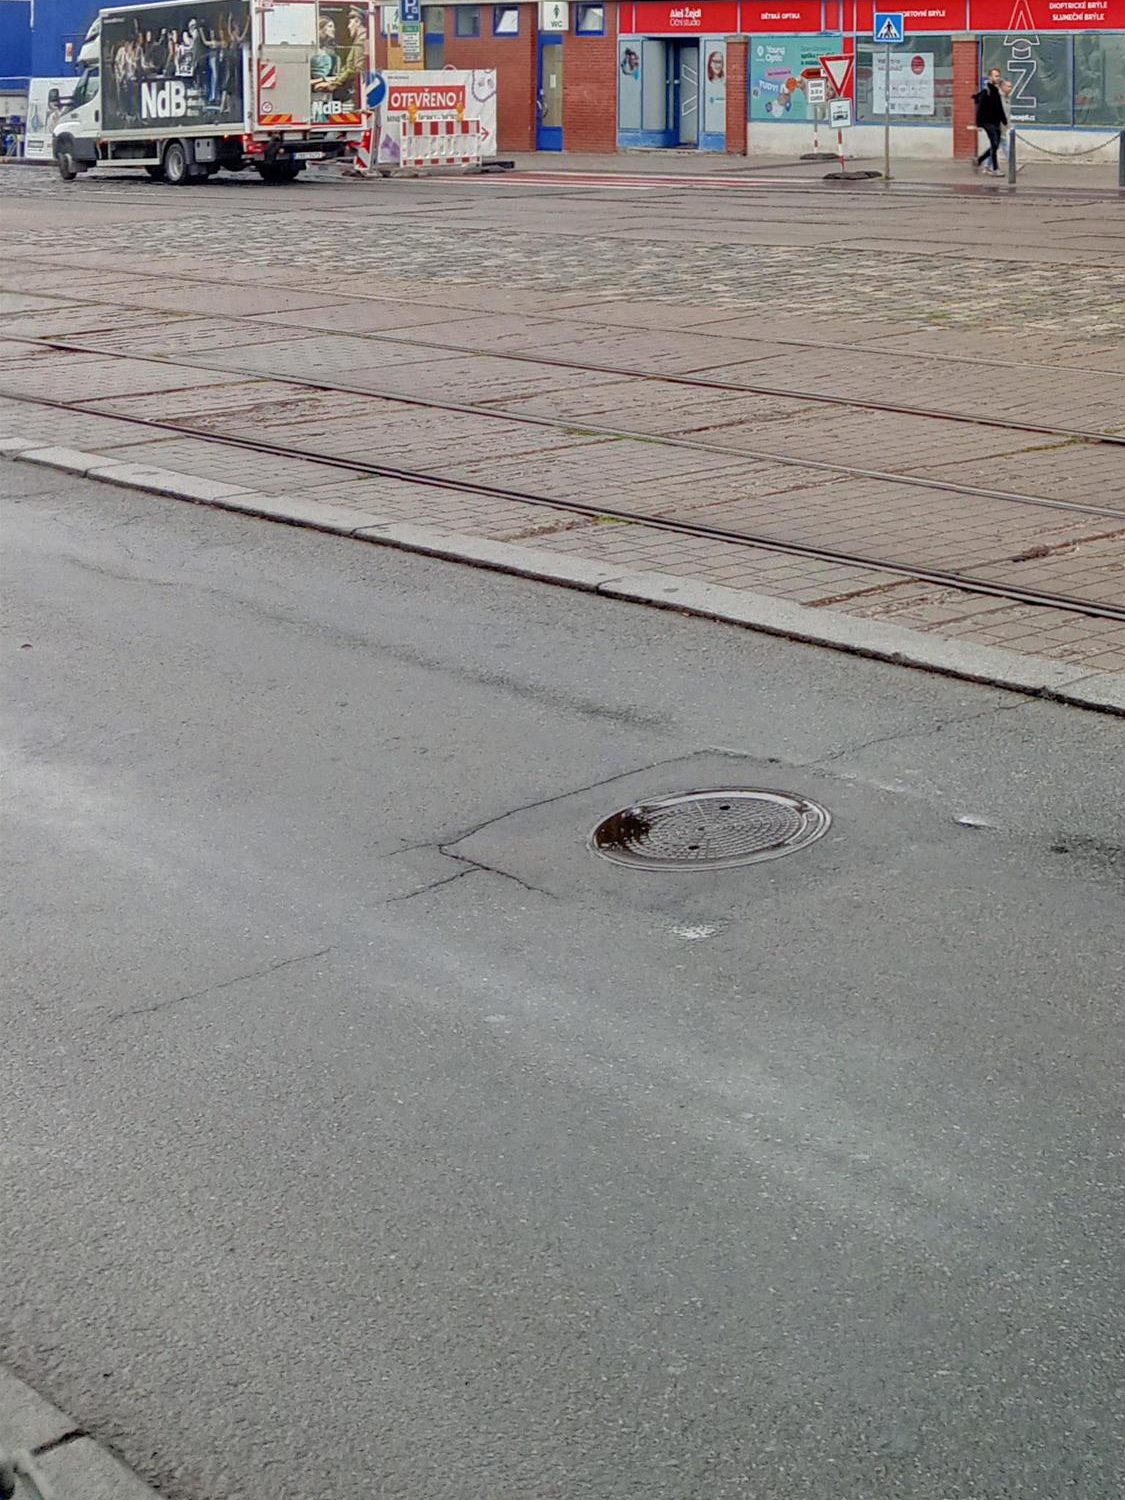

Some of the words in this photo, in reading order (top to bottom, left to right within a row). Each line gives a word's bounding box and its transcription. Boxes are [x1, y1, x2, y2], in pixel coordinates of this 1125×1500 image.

[1048, 1, 1086, 9] DIOPTRICKÉ
[1087, 0, 1108, 8] BRÝLE
[669, 8, 684, 18] Aleš
[684, 6, 702, 20] Žejdl
[1052, 13, 1083, 21] SLUNEČNÍ
[1084, 12, 1104, 20] BRÝLE
[551, 20, 563, 28] WC
[140, 81, 187, 119] NdB
[390, 88, 457, 108] OTEVŘENO
[311, 101, 342, 116] NdB
